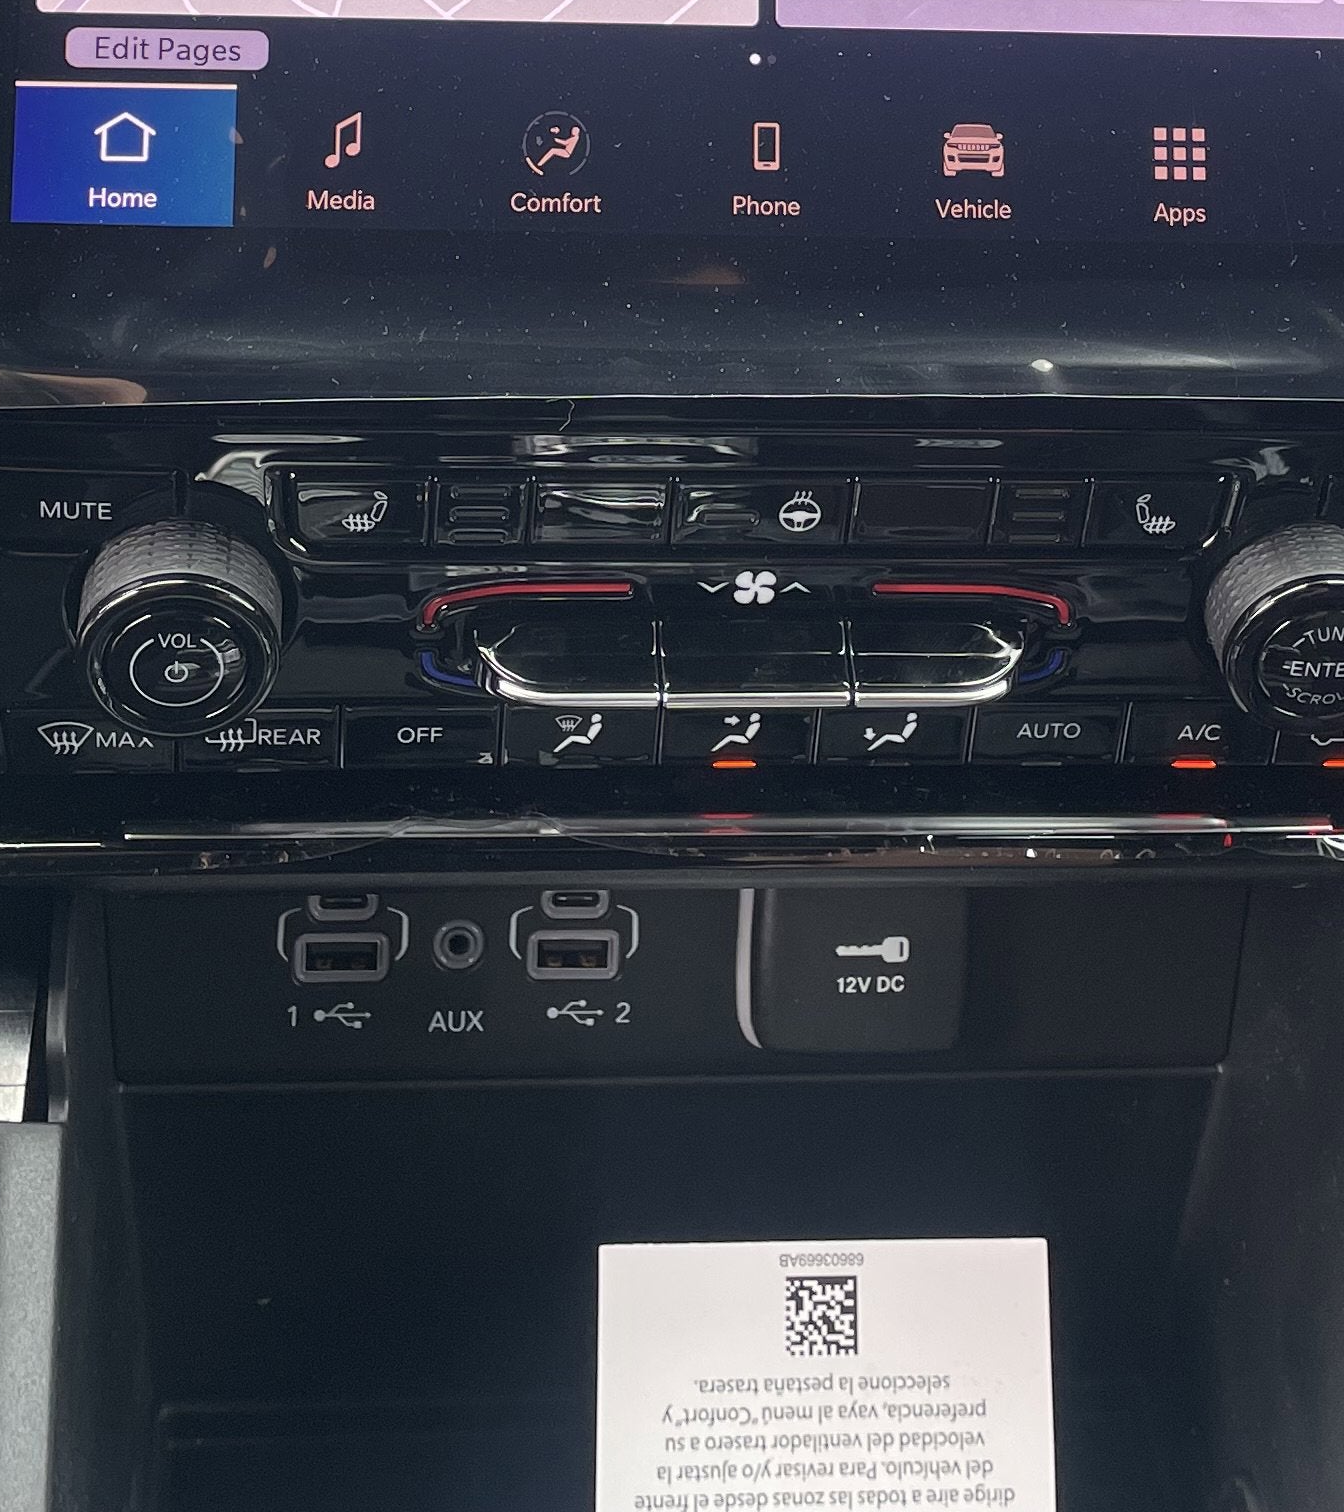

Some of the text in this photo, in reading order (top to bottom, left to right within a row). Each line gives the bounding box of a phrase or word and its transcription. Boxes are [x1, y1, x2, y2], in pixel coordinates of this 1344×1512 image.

[94, 35, 242, 64] Edit Pages
[87, 186, 159, 209] Home
[306, 188, 376, 212] Media
[510, 191, 602, 215] Comfort
[732, 193, 802, 217] Phone
[935, 197, 1013, 221] Vehicle
[1153, 201, 1208, 228] Apps
[39, 499, 114, 521] MUTE
[156, 631, 198, 650] VOL
[257, 727, 322, 746] REAR
[396, 726, 444, 745] OFF
[1015, 721, 1082, 741] AUTO
[1176, 722, 1222, 743] A/C
[835, 975, 906, 994] 12V DC
[286, 1005, 298, 1028] 1
[427, 1009, 485, 1034] AUX
[614, 1001, 632, 1026] 2
[693, 1373, 951, 1397] seleccione la pestaña trasera.
[660, 1404, 674, 1423] y
[762, 1405, 813, 1427] menú
[818, 1405, 834, 1424] al
[837, 1403, 880, 1422] vaya
[882, 1399, 988, 1425] preferencia,
[664, 1431, 986, 1455] velocidad del ventilador trasero a su
[656, 1465, 672, 1485] la
[676, 1460, 738, 1486] ajustar
[743, 1462, 772, 1483] y/o
[775, 1461, 834, 1483] revisar
[839, 1461, 878, 1481] Para
[966, 1459, 994, 1481] del
[634, 1485, 1016, 1512] dirige aire a todas las zonas desde el frente
